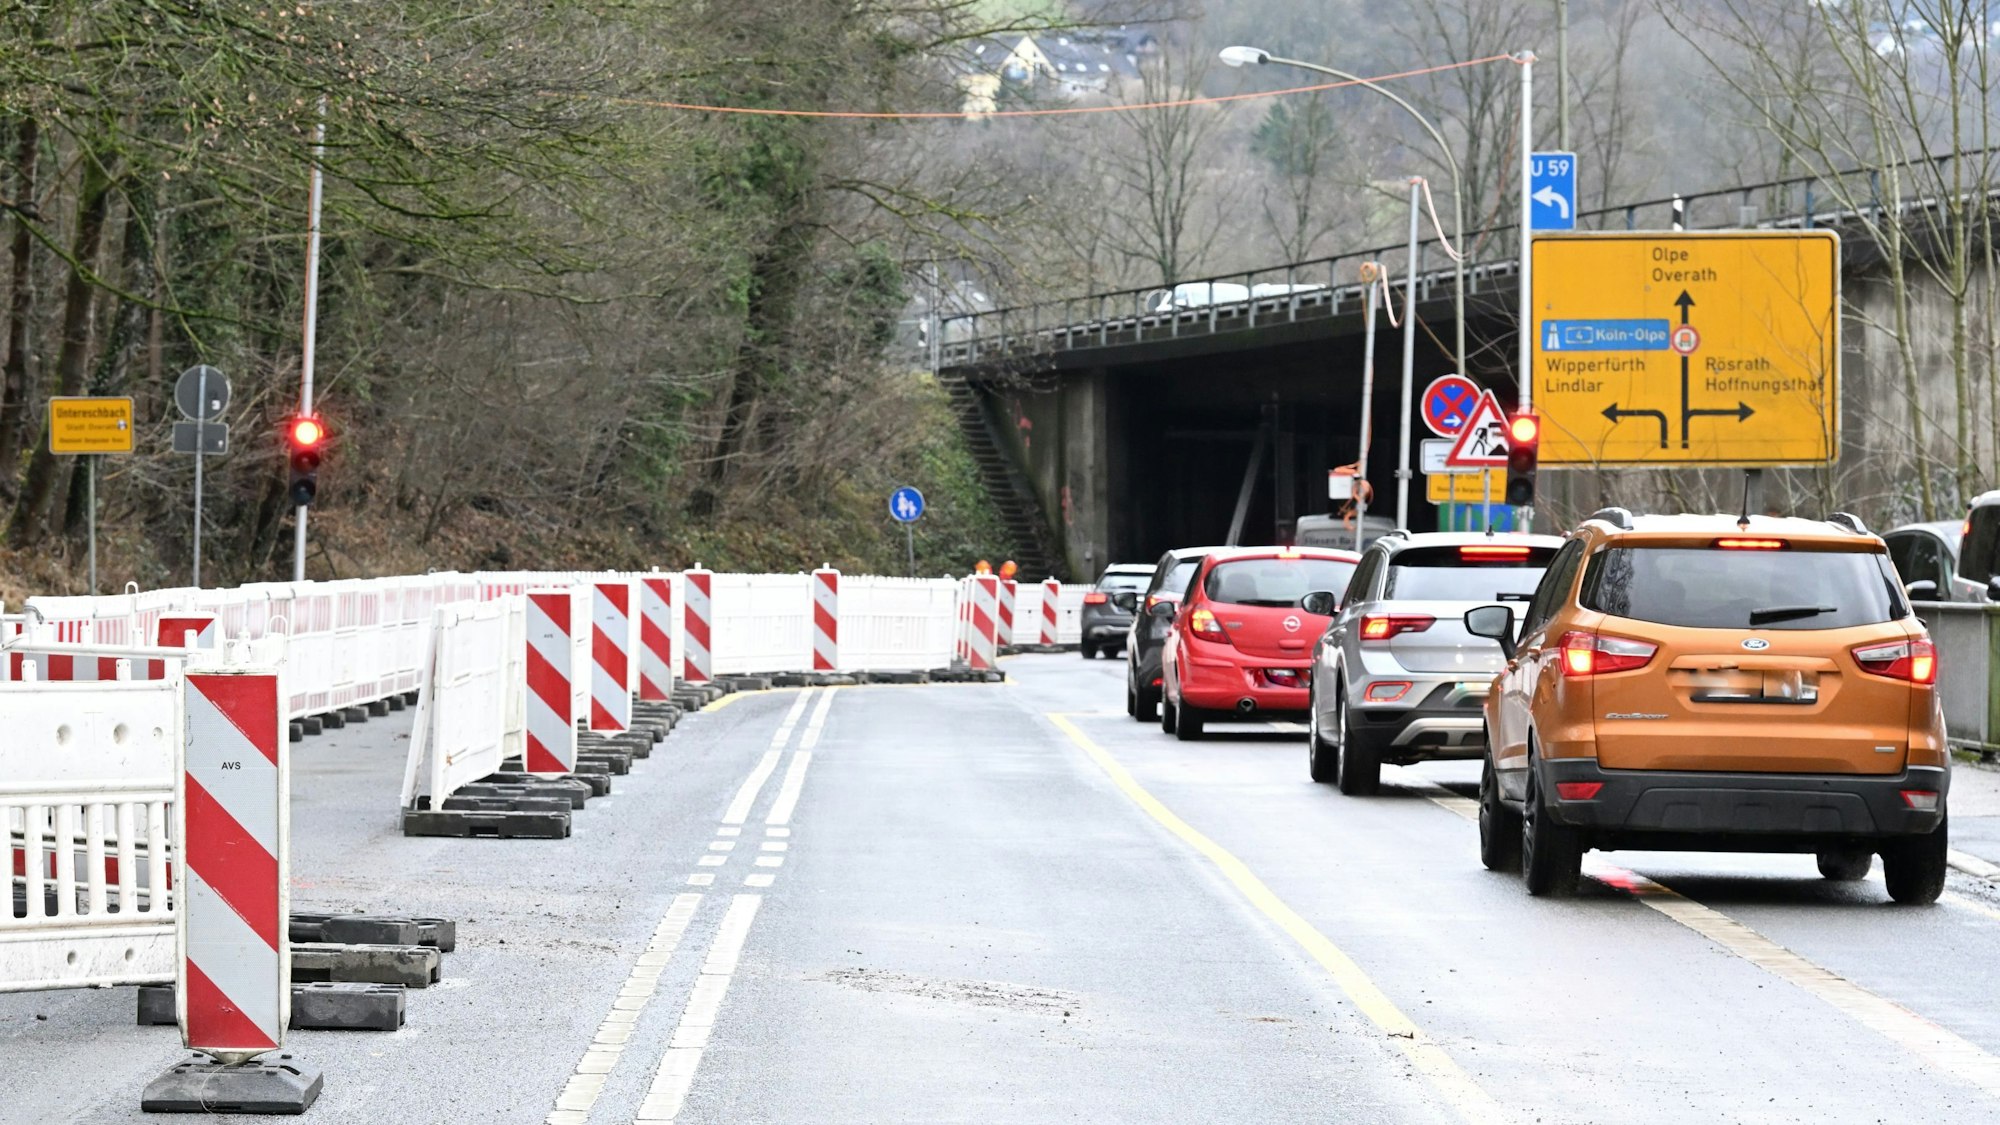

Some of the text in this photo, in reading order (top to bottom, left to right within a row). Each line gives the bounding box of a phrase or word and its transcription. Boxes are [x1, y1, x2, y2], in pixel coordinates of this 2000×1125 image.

[1531, 160, 1570, 177] U 59
[1652, 247, 1689, 264] Olpe
[1652, 267, 1717, 282] Overath
[1575, 327, 1667, 343] 4 Köln-Olpe
[1546, 358, 1646, 376] Wipperfürth
[1705, 356, 1771, 372] Rösrath
[1546, 379, 1604, 393] Lindlar
[56, 407, 126, 419] Untereschbach
[221, 761, 241, 770] AVS
